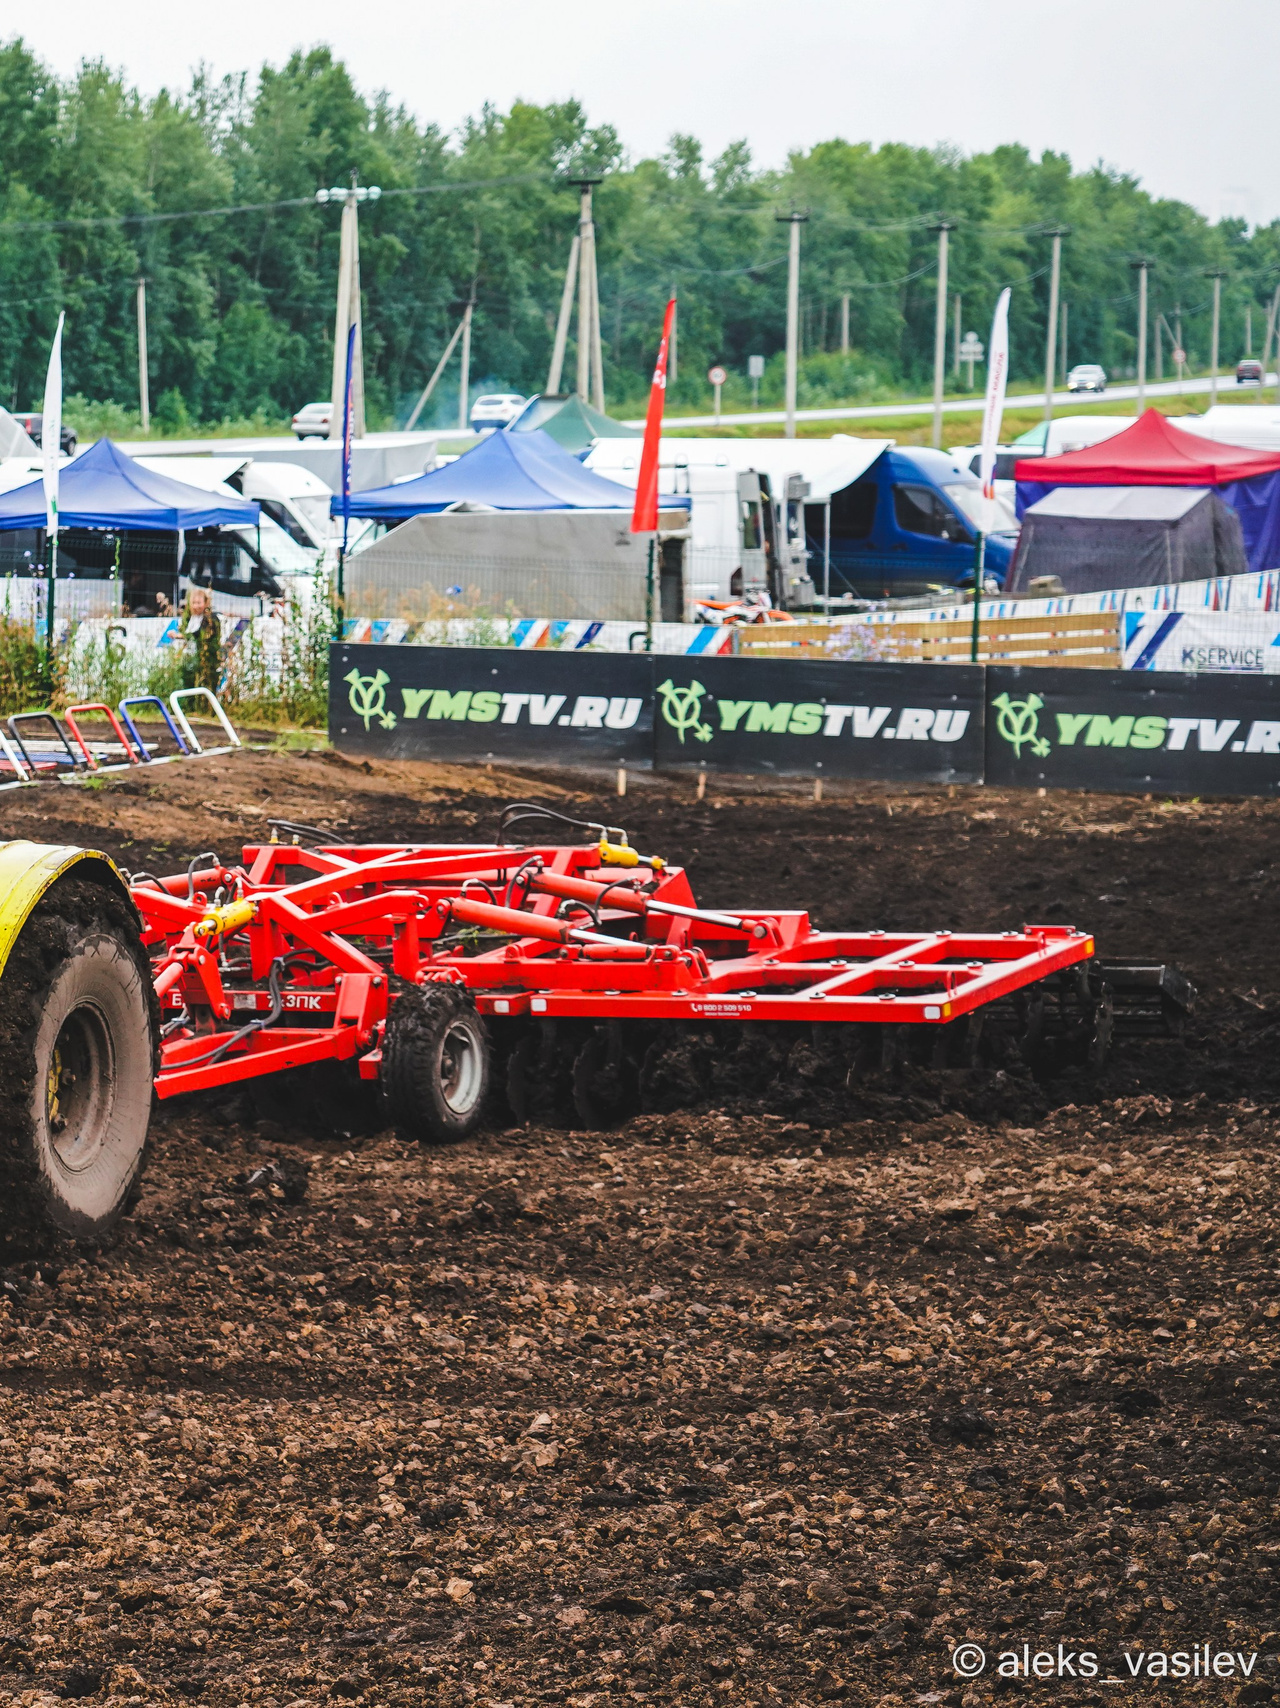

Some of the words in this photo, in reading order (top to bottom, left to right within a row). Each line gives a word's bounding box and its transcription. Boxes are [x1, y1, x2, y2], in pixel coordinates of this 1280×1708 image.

[401, 688, 643, 729] YMSTV.RU
[717, 700, 970, 742] YMSTV.RU
[1056, 713, 1280, 754] YMSTV.R
